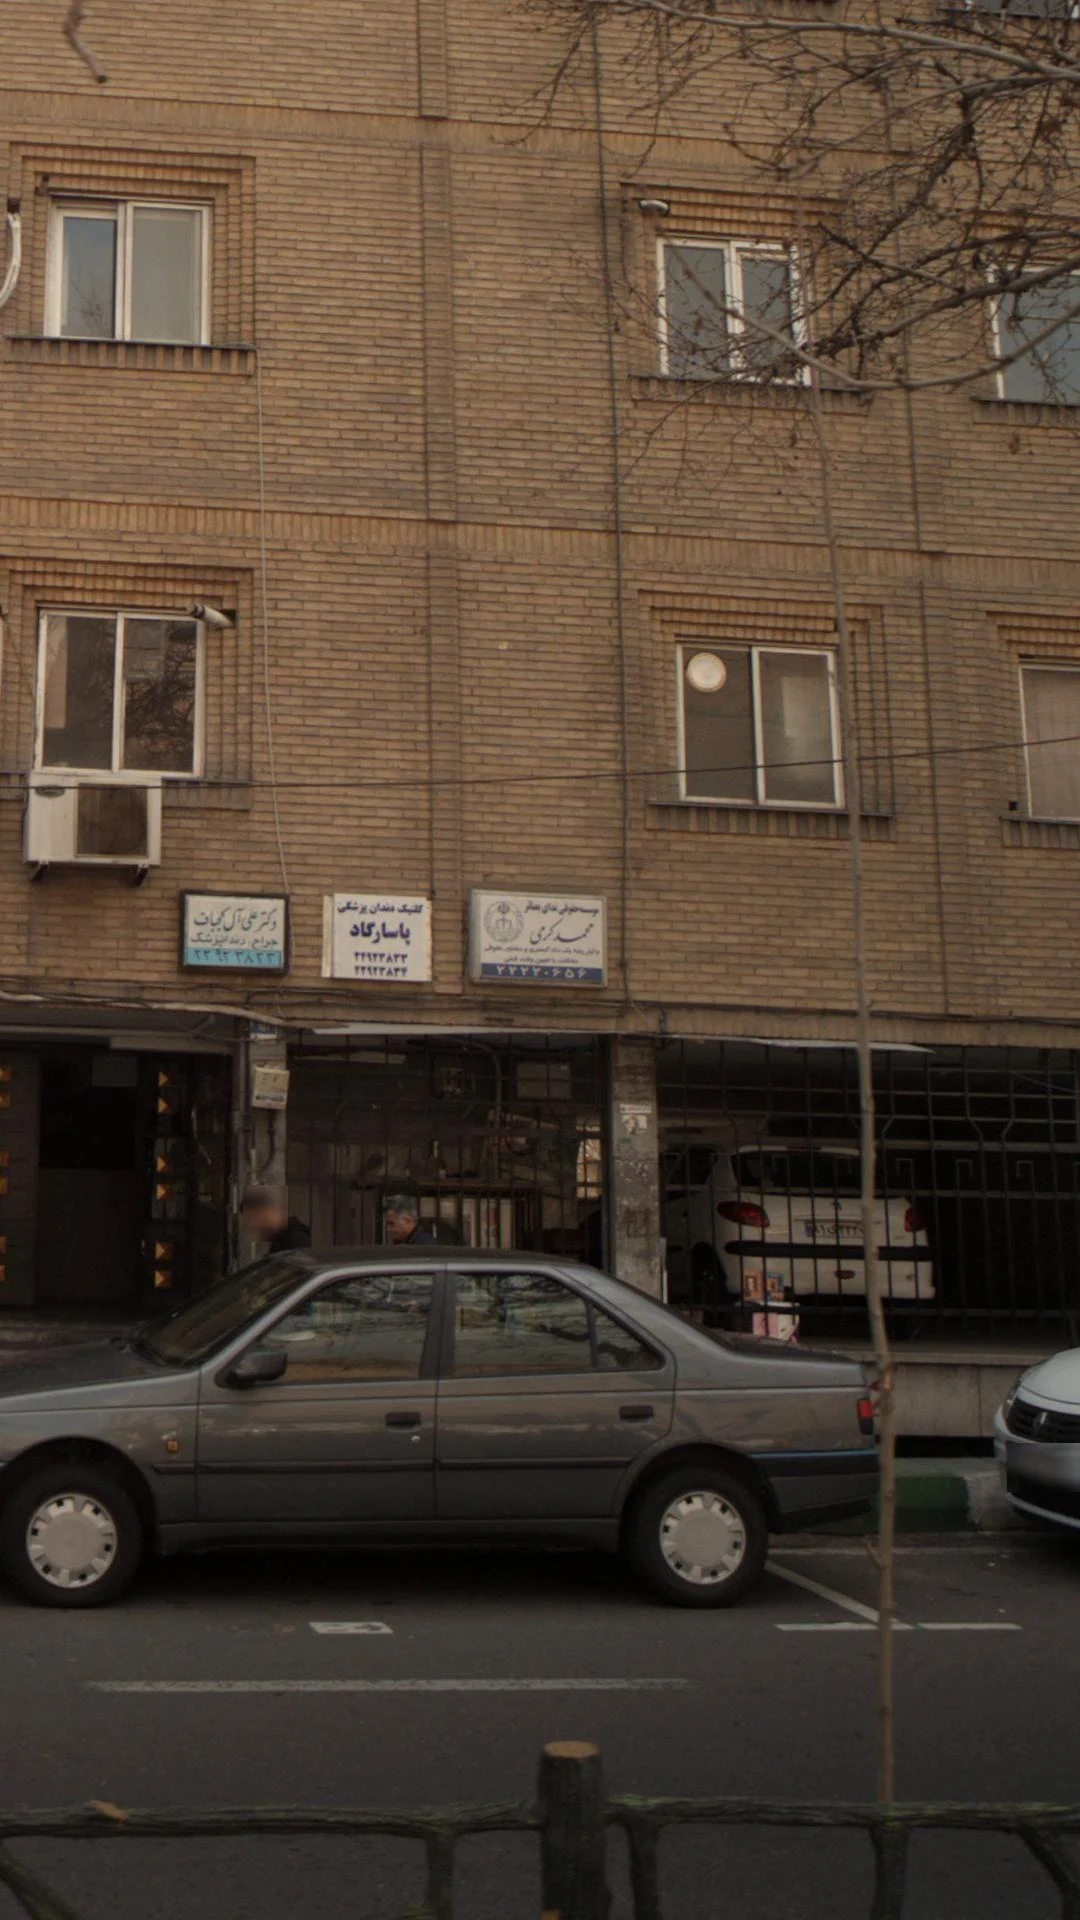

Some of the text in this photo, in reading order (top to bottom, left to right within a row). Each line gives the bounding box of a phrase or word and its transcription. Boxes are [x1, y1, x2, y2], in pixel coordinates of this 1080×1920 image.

[223, 906, 246, 932] آل
[241, 911, 258, 931] علی
[253, 907, 278, 933] دکتر
[337, 901, 424, 916] کلینیک دندان پزشکی
[350, 920, 411, 946] پاسارگاد
[529, 916, 594, 945] محمد کرمی
[496, 965, 587, 979] ۲۲۲۲۰۶۵۶
